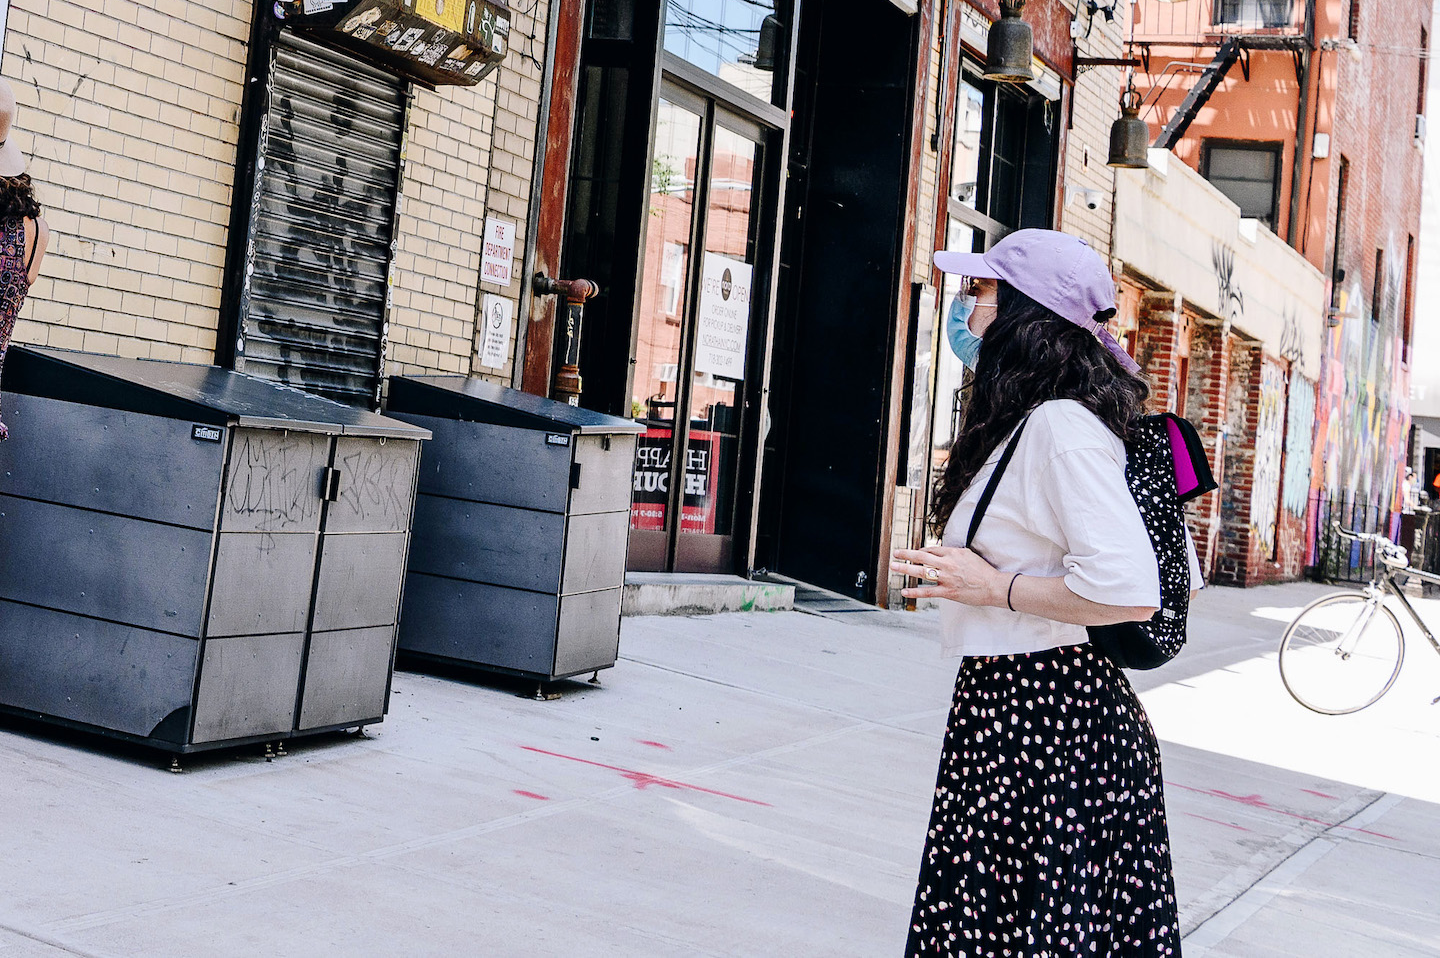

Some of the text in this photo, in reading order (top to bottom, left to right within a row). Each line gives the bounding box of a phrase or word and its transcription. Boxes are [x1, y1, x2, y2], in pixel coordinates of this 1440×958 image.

[495, 225, 505, 240] FIRE
[484, 242, 512, 261] DEPARTMENT
[484, 261, 508, 280] CONNECTION
[732, 284, 749, 303] OPEN
